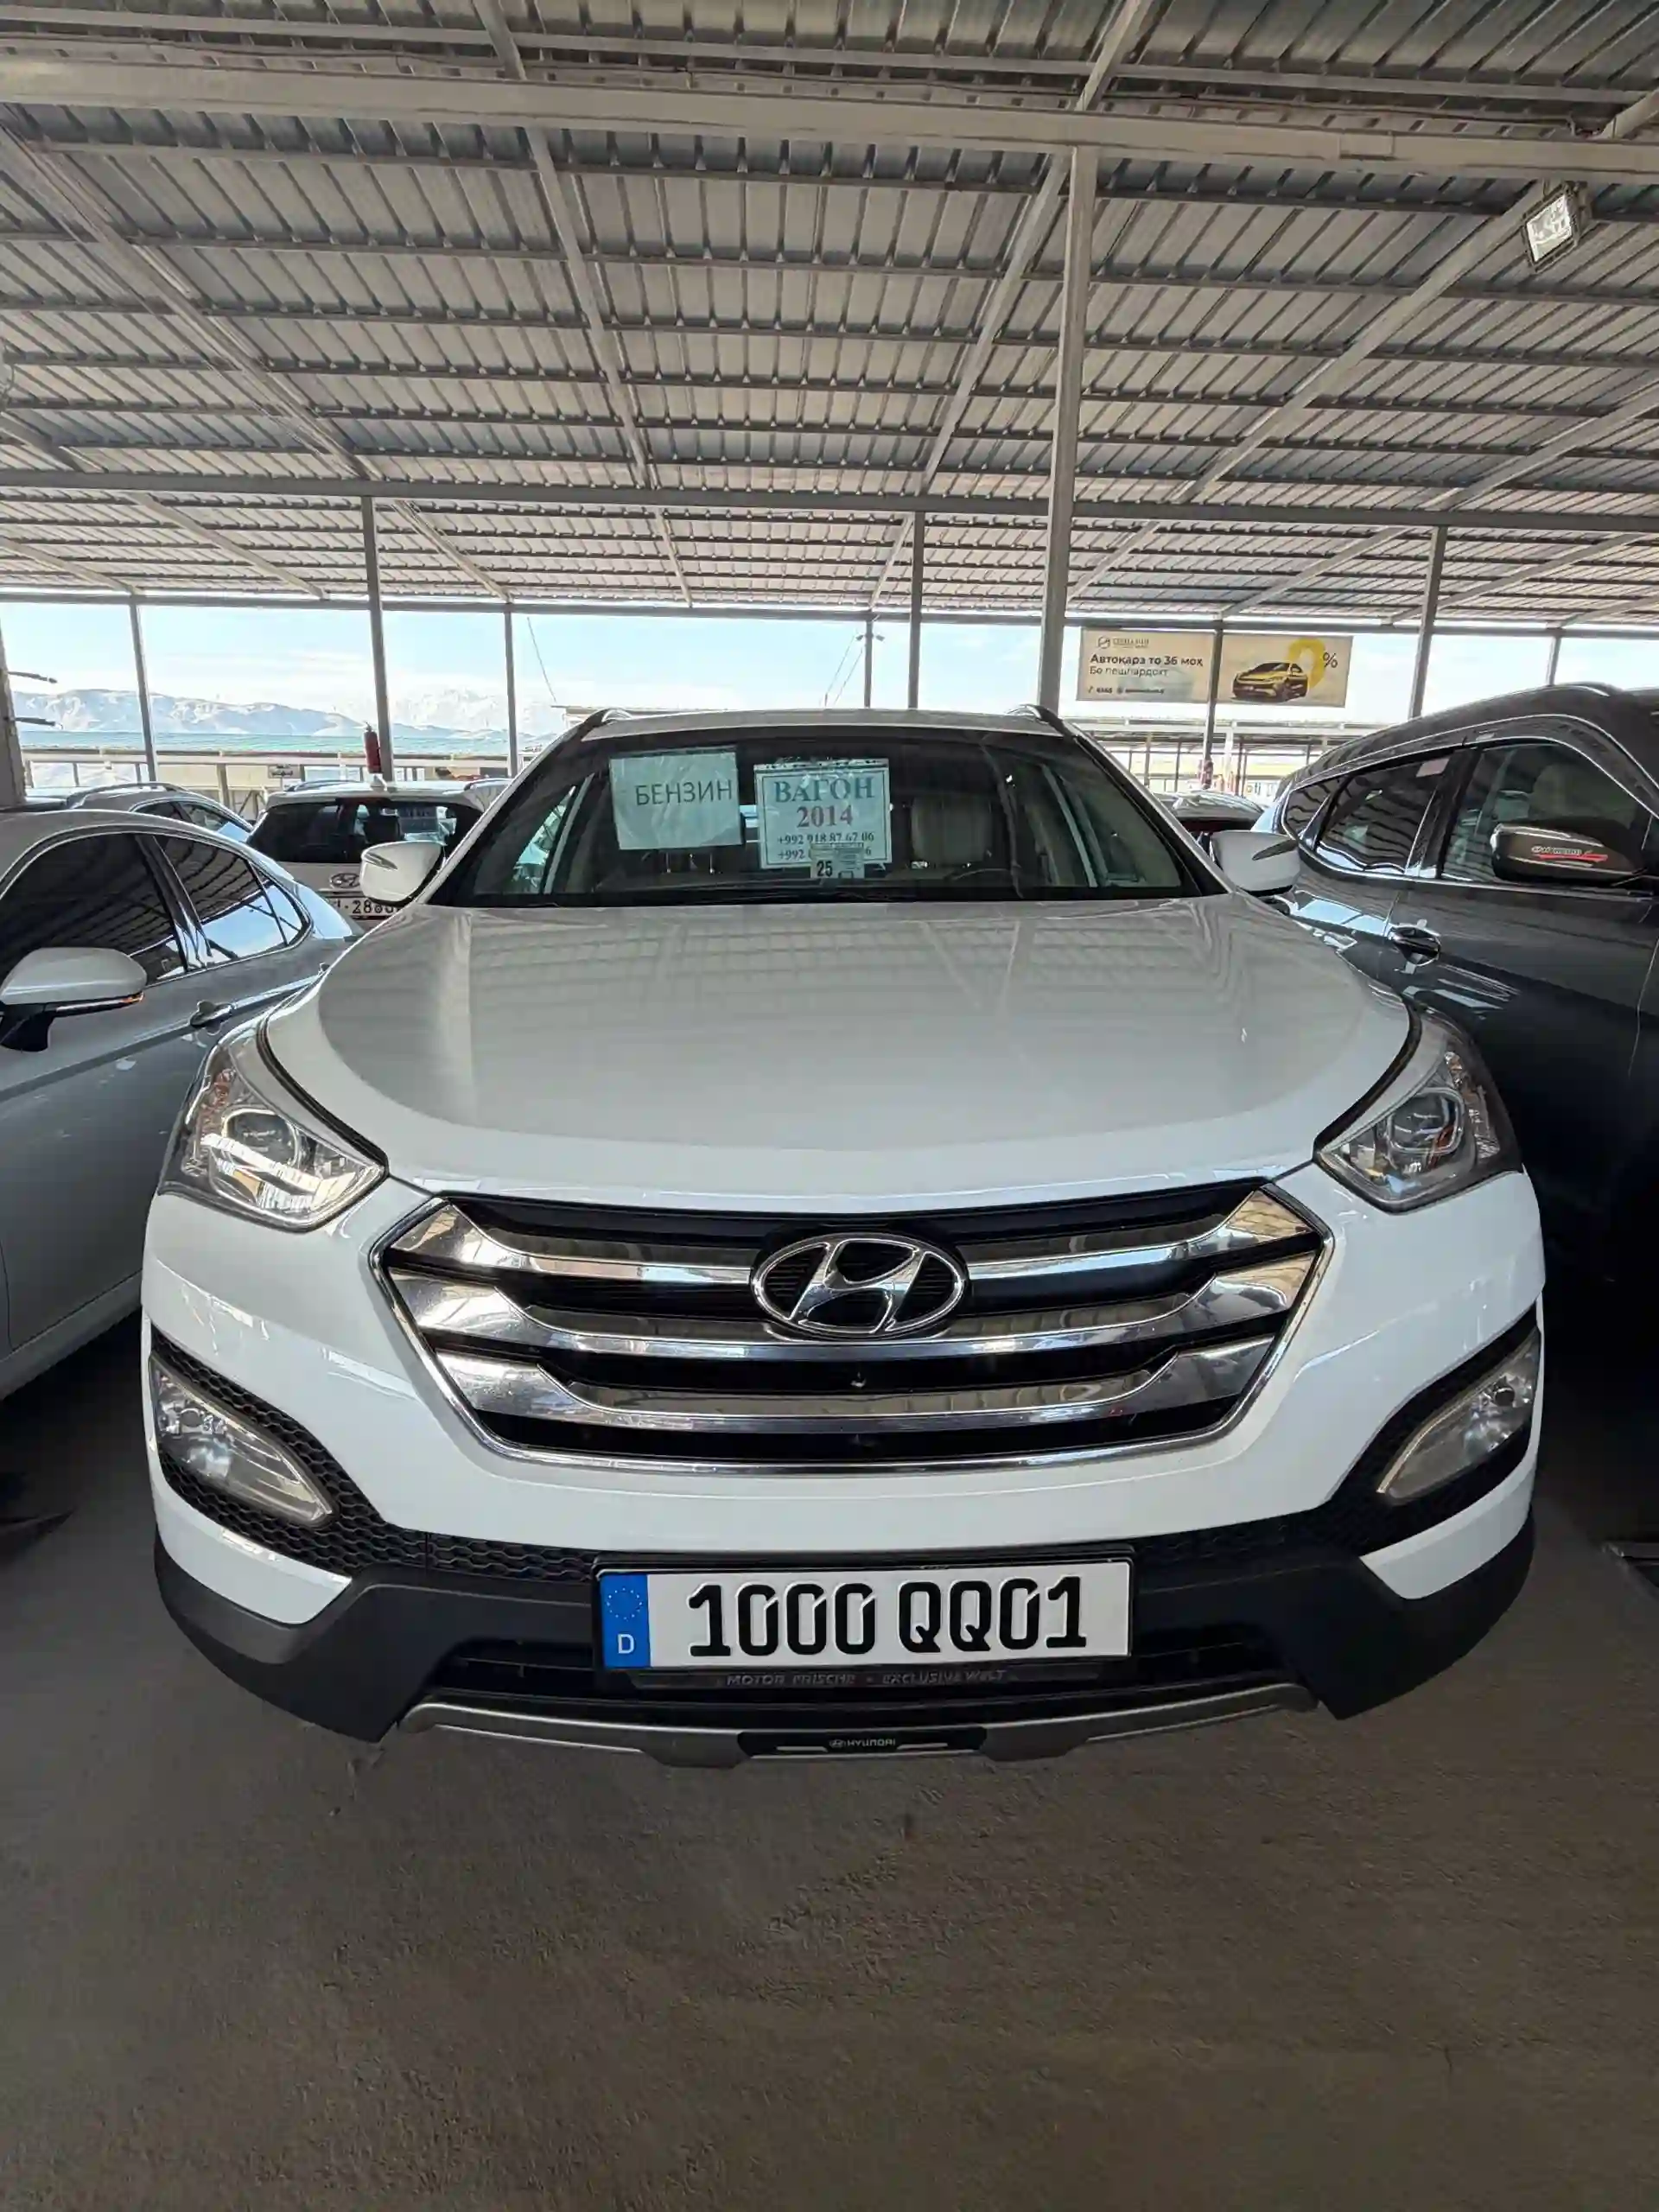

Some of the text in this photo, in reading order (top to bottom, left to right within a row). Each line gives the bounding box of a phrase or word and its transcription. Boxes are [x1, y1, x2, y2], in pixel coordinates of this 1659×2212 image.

[1149, 657, 1161, 665] то
[1164, 656, 1178, 665] 36
[635, 779, 733, 806] БЕНЗИН
[774, 776, 875, 804] ВАГОН
[796, 804, 854, 828] 2014
[778, 834, 804, 845] +992
[778, 849, 804, 860] +992
[817, 861, 833, 877] 25
[688, 1576, 1088, 1657] 1000 QQ01
[617, 1634, 634, 1654] D
[727, 1675, 785, 1686] MOTOR
[847, 1738, 896, 1747] HYUNDAI
